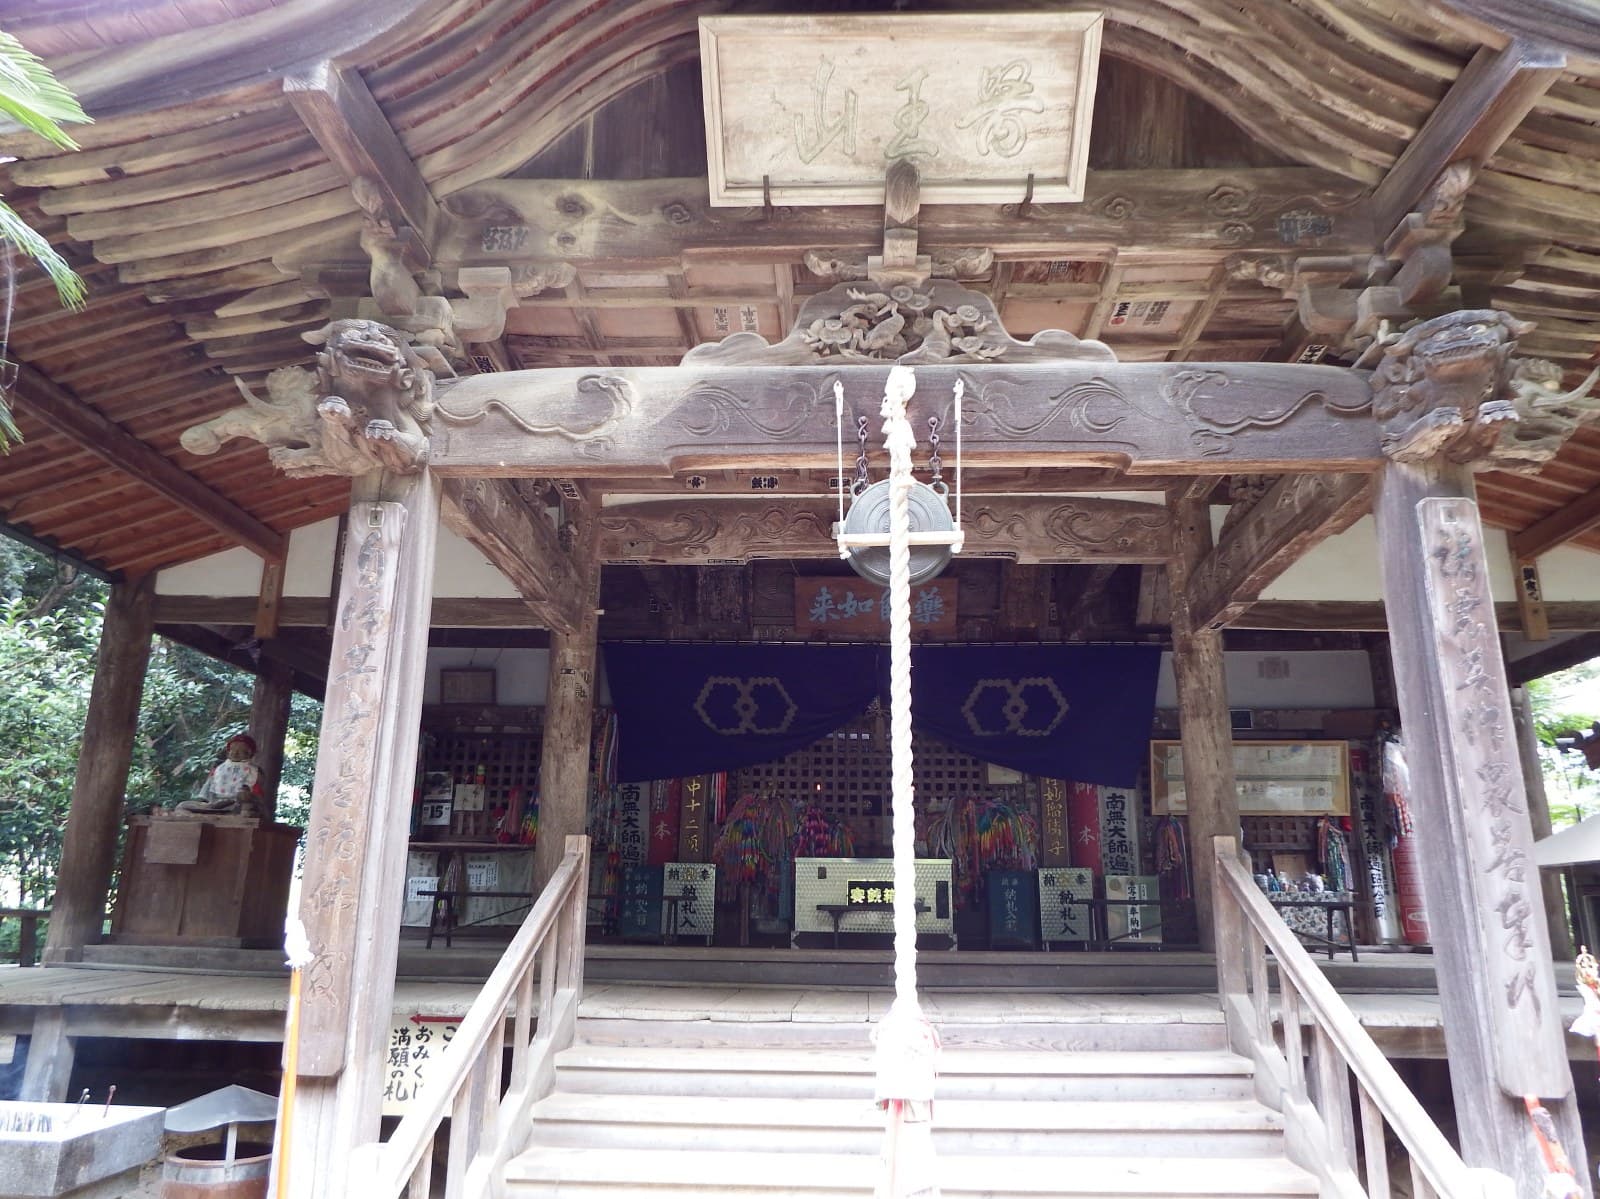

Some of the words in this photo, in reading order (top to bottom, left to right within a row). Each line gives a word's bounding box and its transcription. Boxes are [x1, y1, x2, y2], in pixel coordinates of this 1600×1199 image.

[621, 784, 641, 869] 南無大師遍
[1106, 793, 1129, 876] 南無大師遍
[383, 1026, 412, 1102] 満願の札
[412, 1025, 434, 1100] おみくじ
